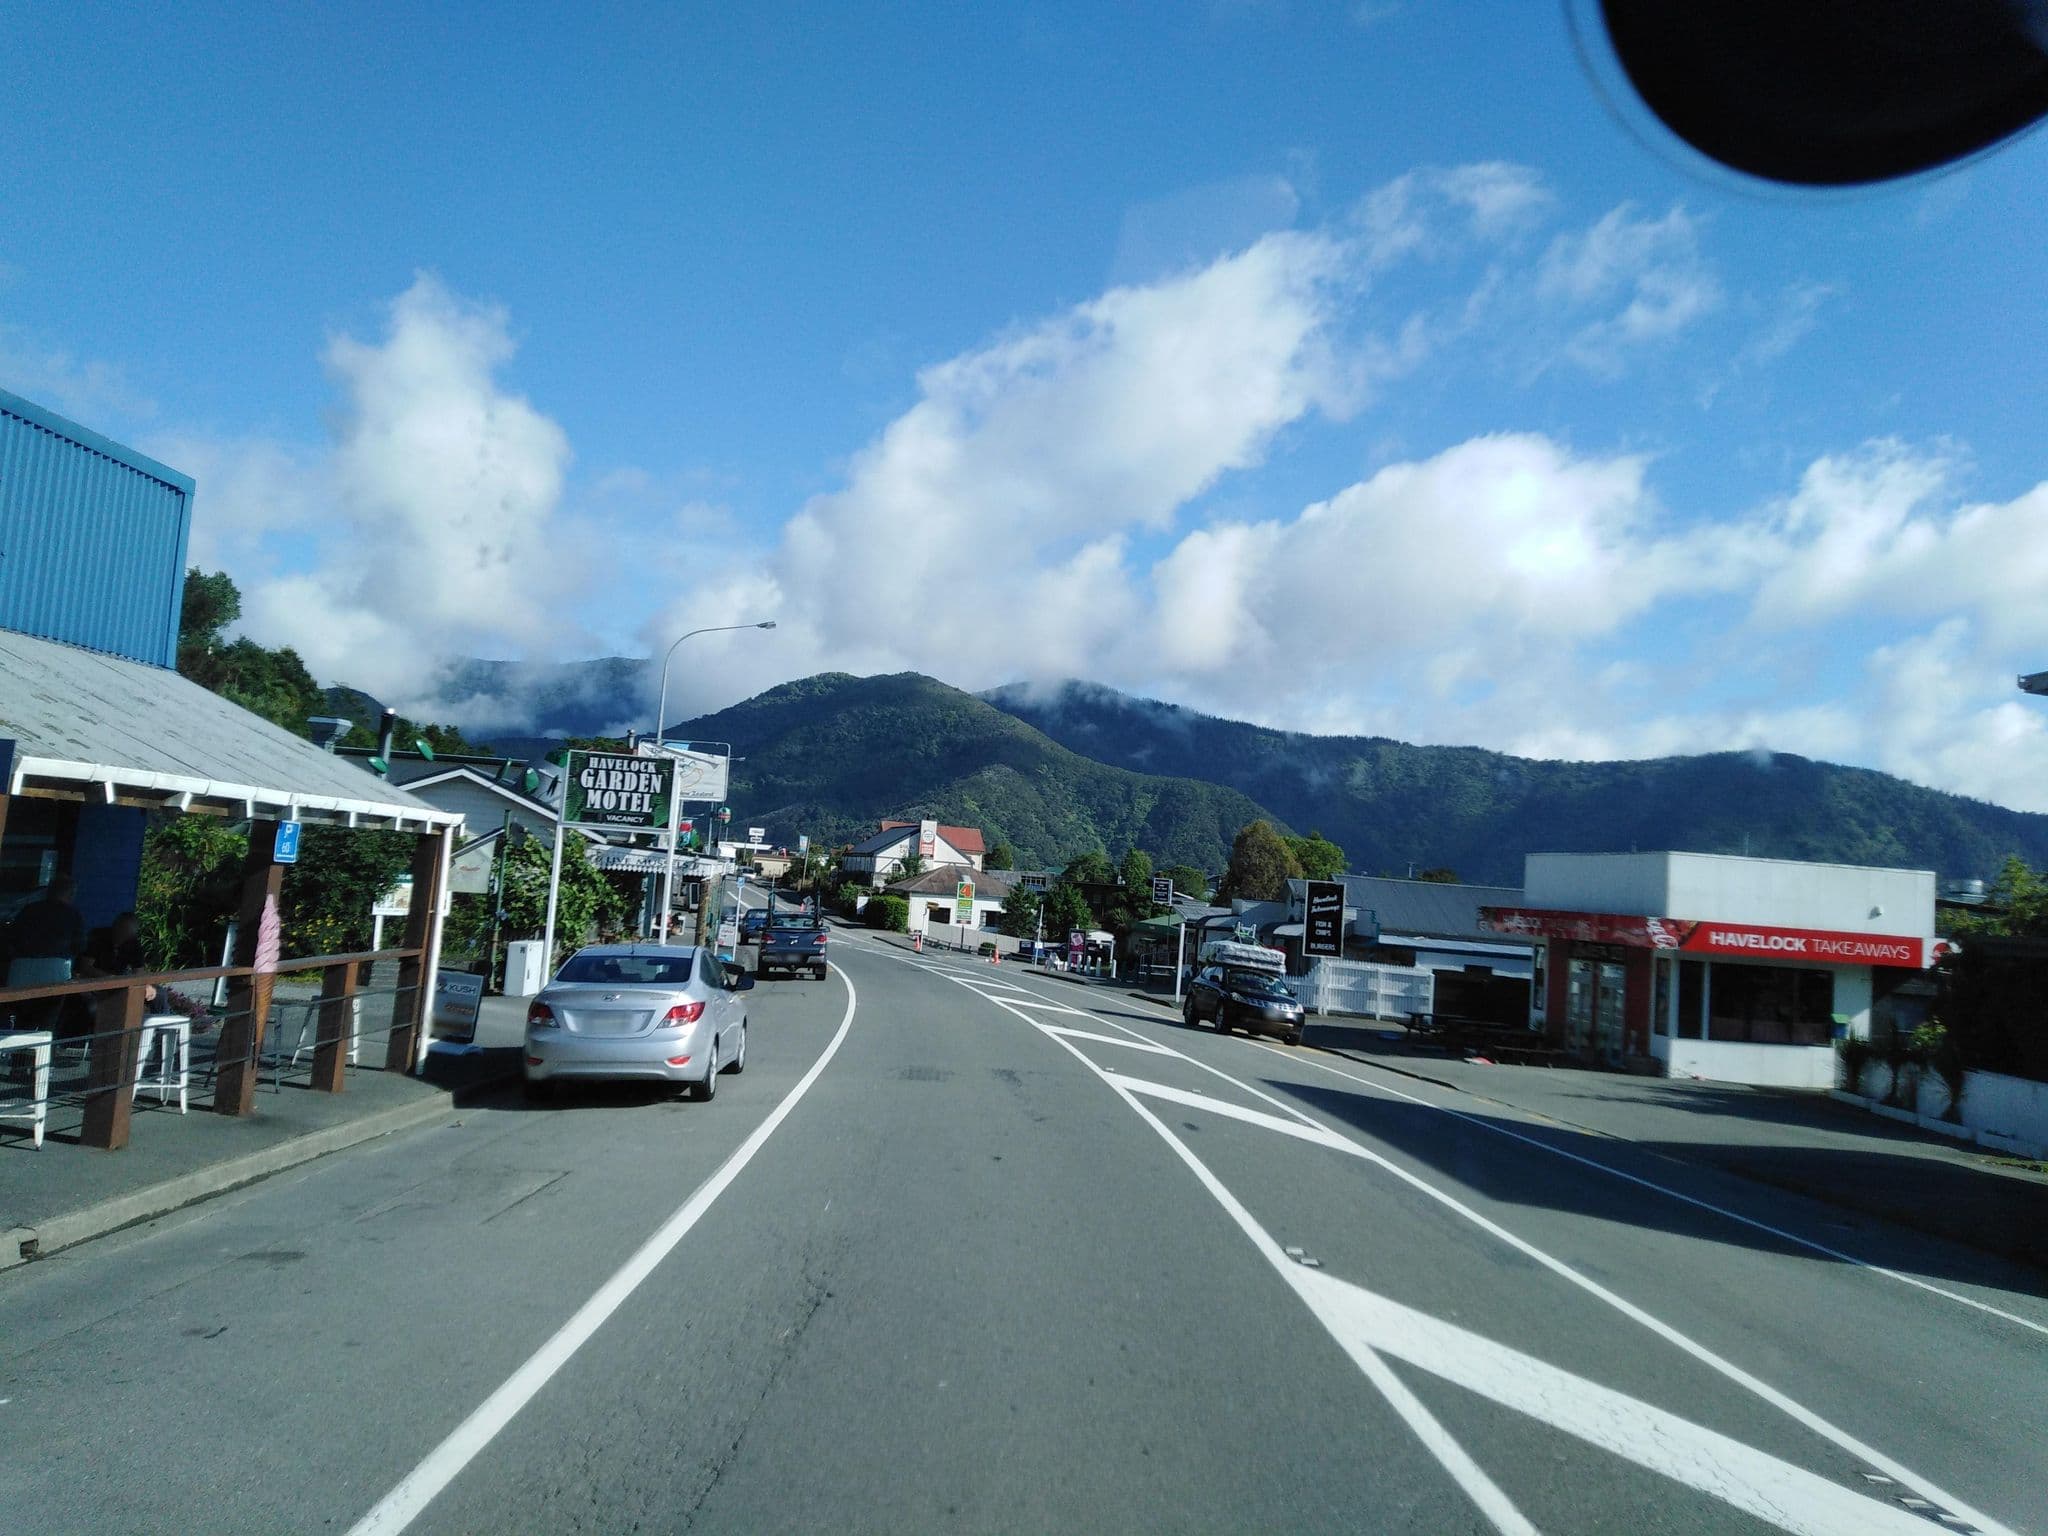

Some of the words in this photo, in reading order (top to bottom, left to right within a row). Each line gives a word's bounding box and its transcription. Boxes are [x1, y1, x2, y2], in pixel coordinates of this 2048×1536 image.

[589, 757, 656, 773] HAVELOCK
[580, 769, 663, 793] GARDEN
[586, 790, 653, 813] MOTEL
[606, 814, 645, 824] VACANCY
[1709, 931, 1807, 952] HAVELOCK
[1813, 938, 1910, 960] TAKEAWAYS
